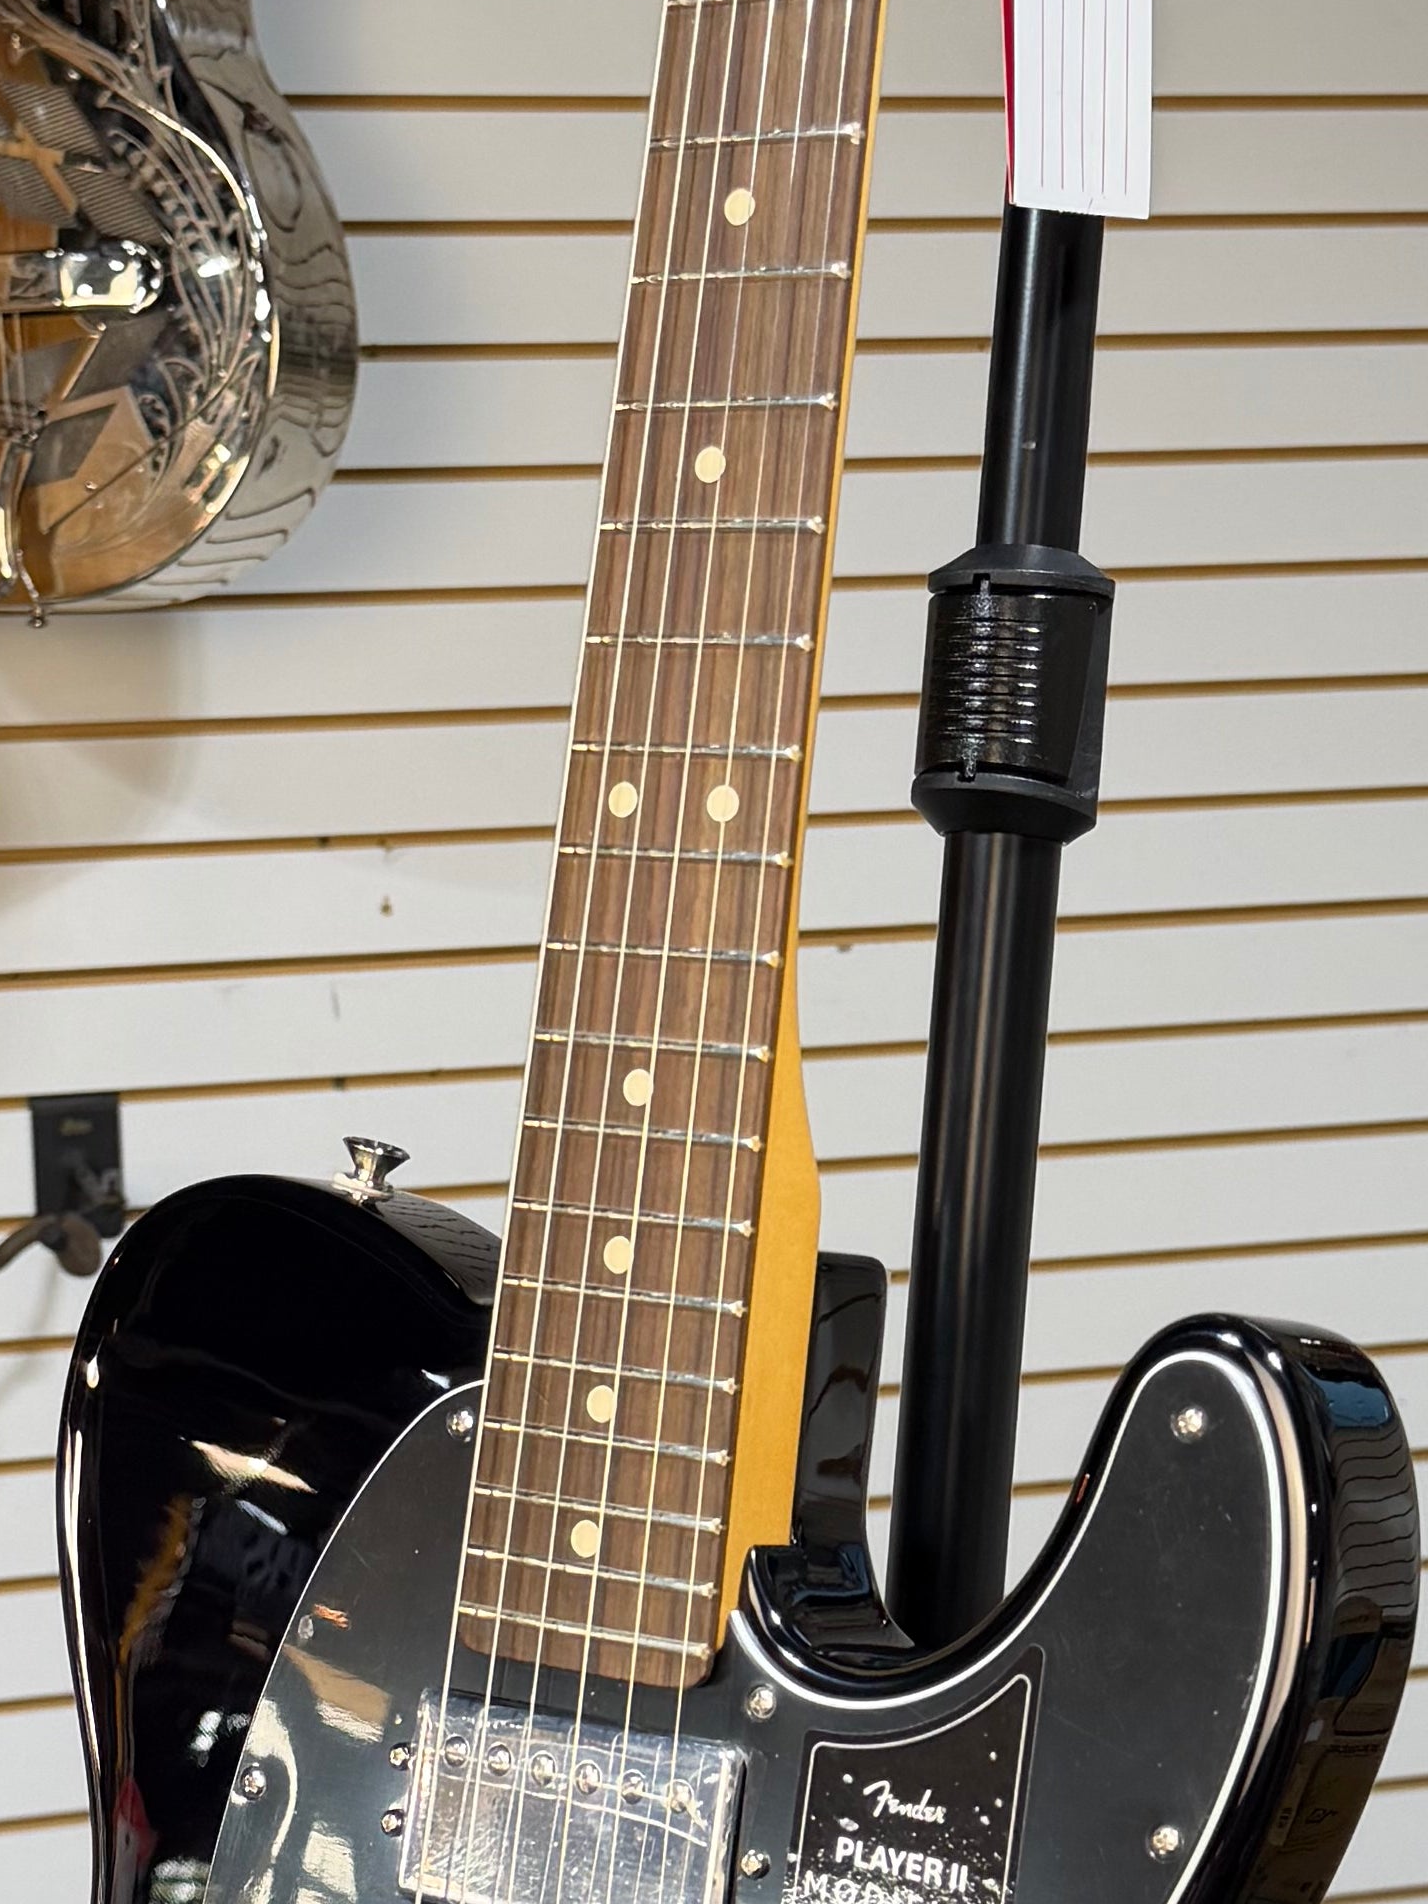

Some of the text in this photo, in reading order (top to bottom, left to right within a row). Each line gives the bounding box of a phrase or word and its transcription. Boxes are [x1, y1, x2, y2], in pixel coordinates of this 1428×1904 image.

[863, 1780, 947, 1824] Fender
[835, 1836, 969, 1894] PLAYER II
